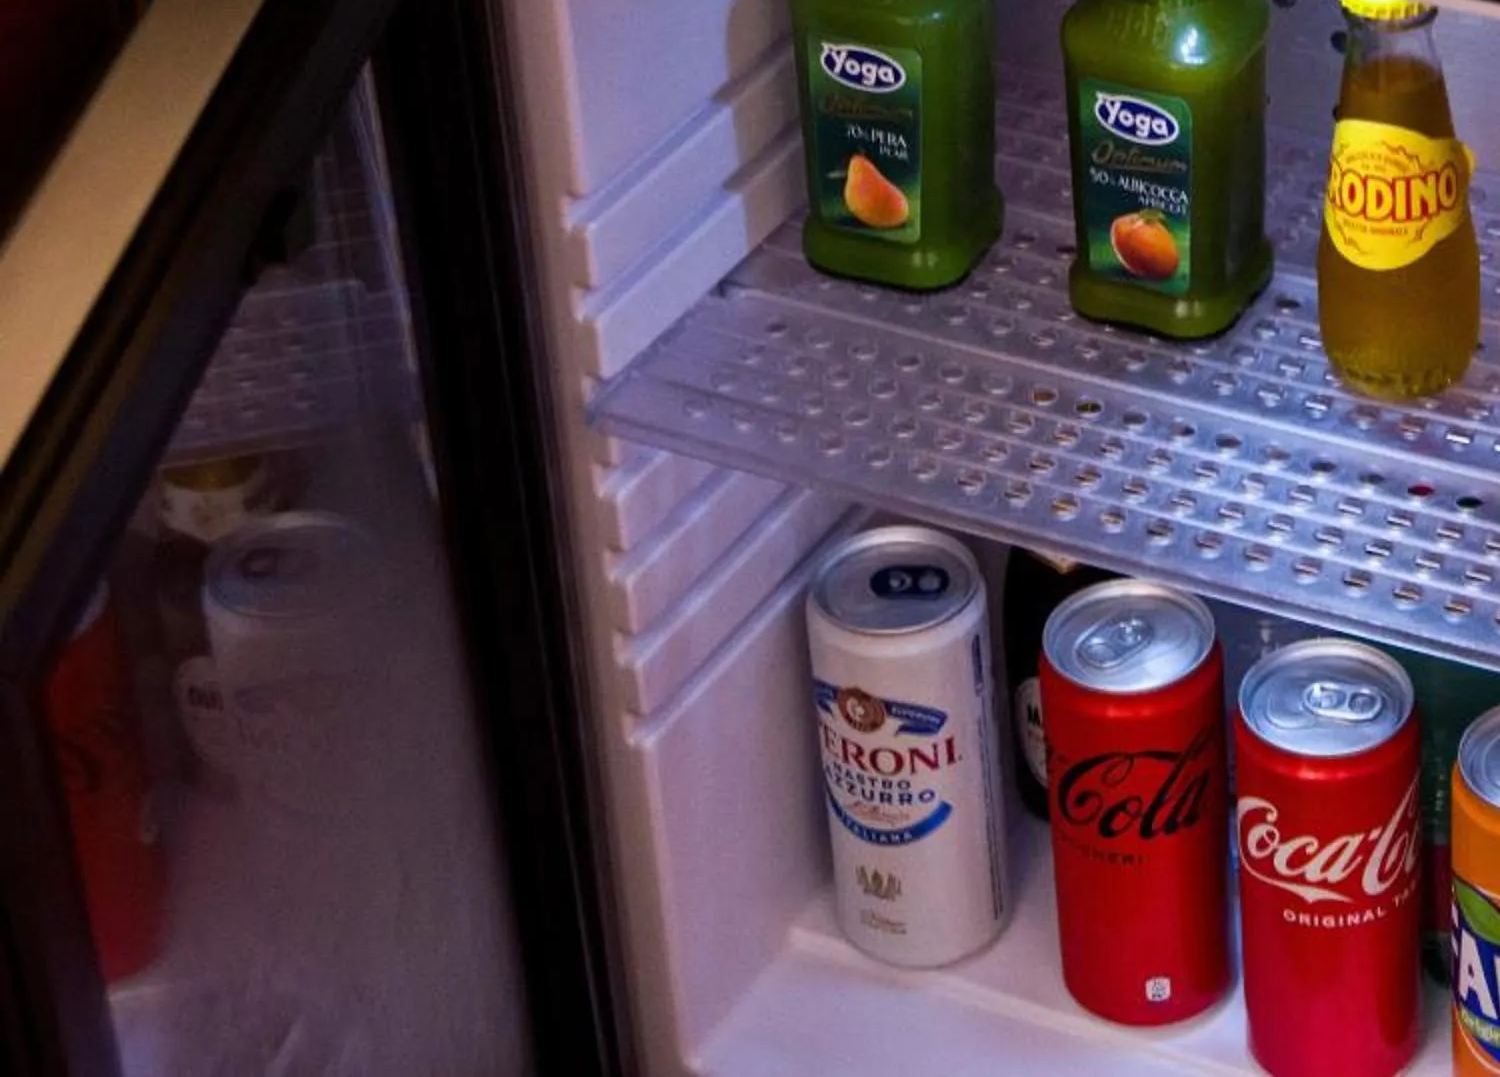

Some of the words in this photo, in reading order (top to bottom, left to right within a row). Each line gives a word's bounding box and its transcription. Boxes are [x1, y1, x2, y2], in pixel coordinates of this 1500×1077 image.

[832, 49, 896, 86] Yoga
[1105, 99, 1169, 138] Yoga
[1328, 156, 1458, 221] RODINO
[822, 724, 957, 776] ERONI
[1283, 906, 1386, 928] ORIGINAL
